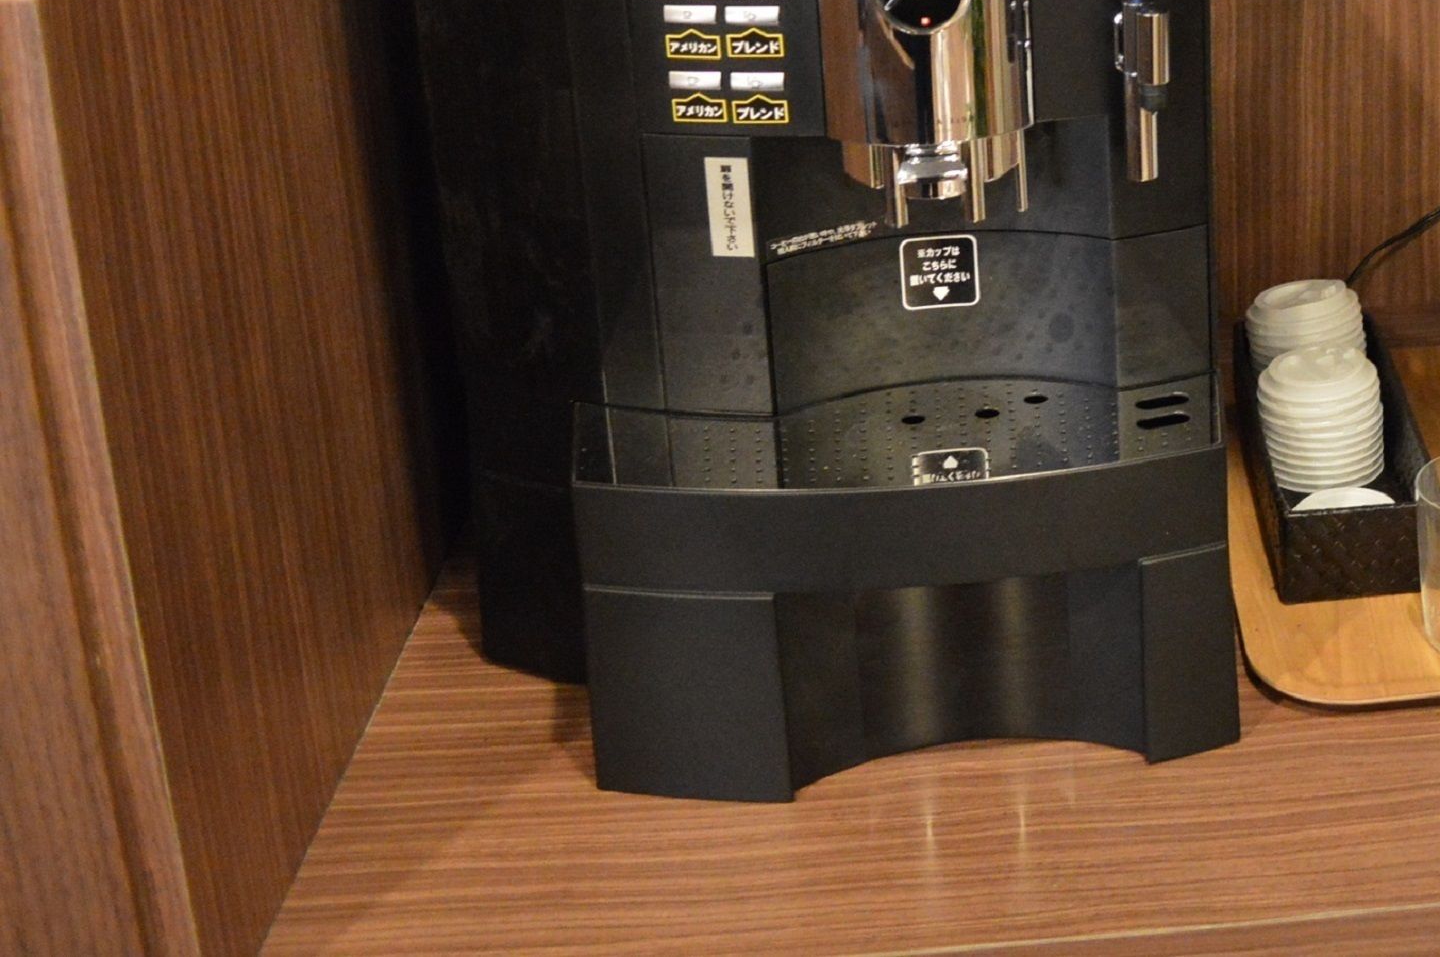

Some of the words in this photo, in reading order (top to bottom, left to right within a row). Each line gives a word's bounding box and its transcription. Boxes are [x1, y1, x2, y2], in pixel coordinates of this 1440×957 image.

[669, 41, 718, 54] アメリカン
[731, 39, 780, 55] ブレンド
[676, 104, 725, 118] アメリカン
[736, 105, 786, 121] ブレンド
[921, 258, 958, 272] こちらに
[908, 271, 972, 287] 置いてください
